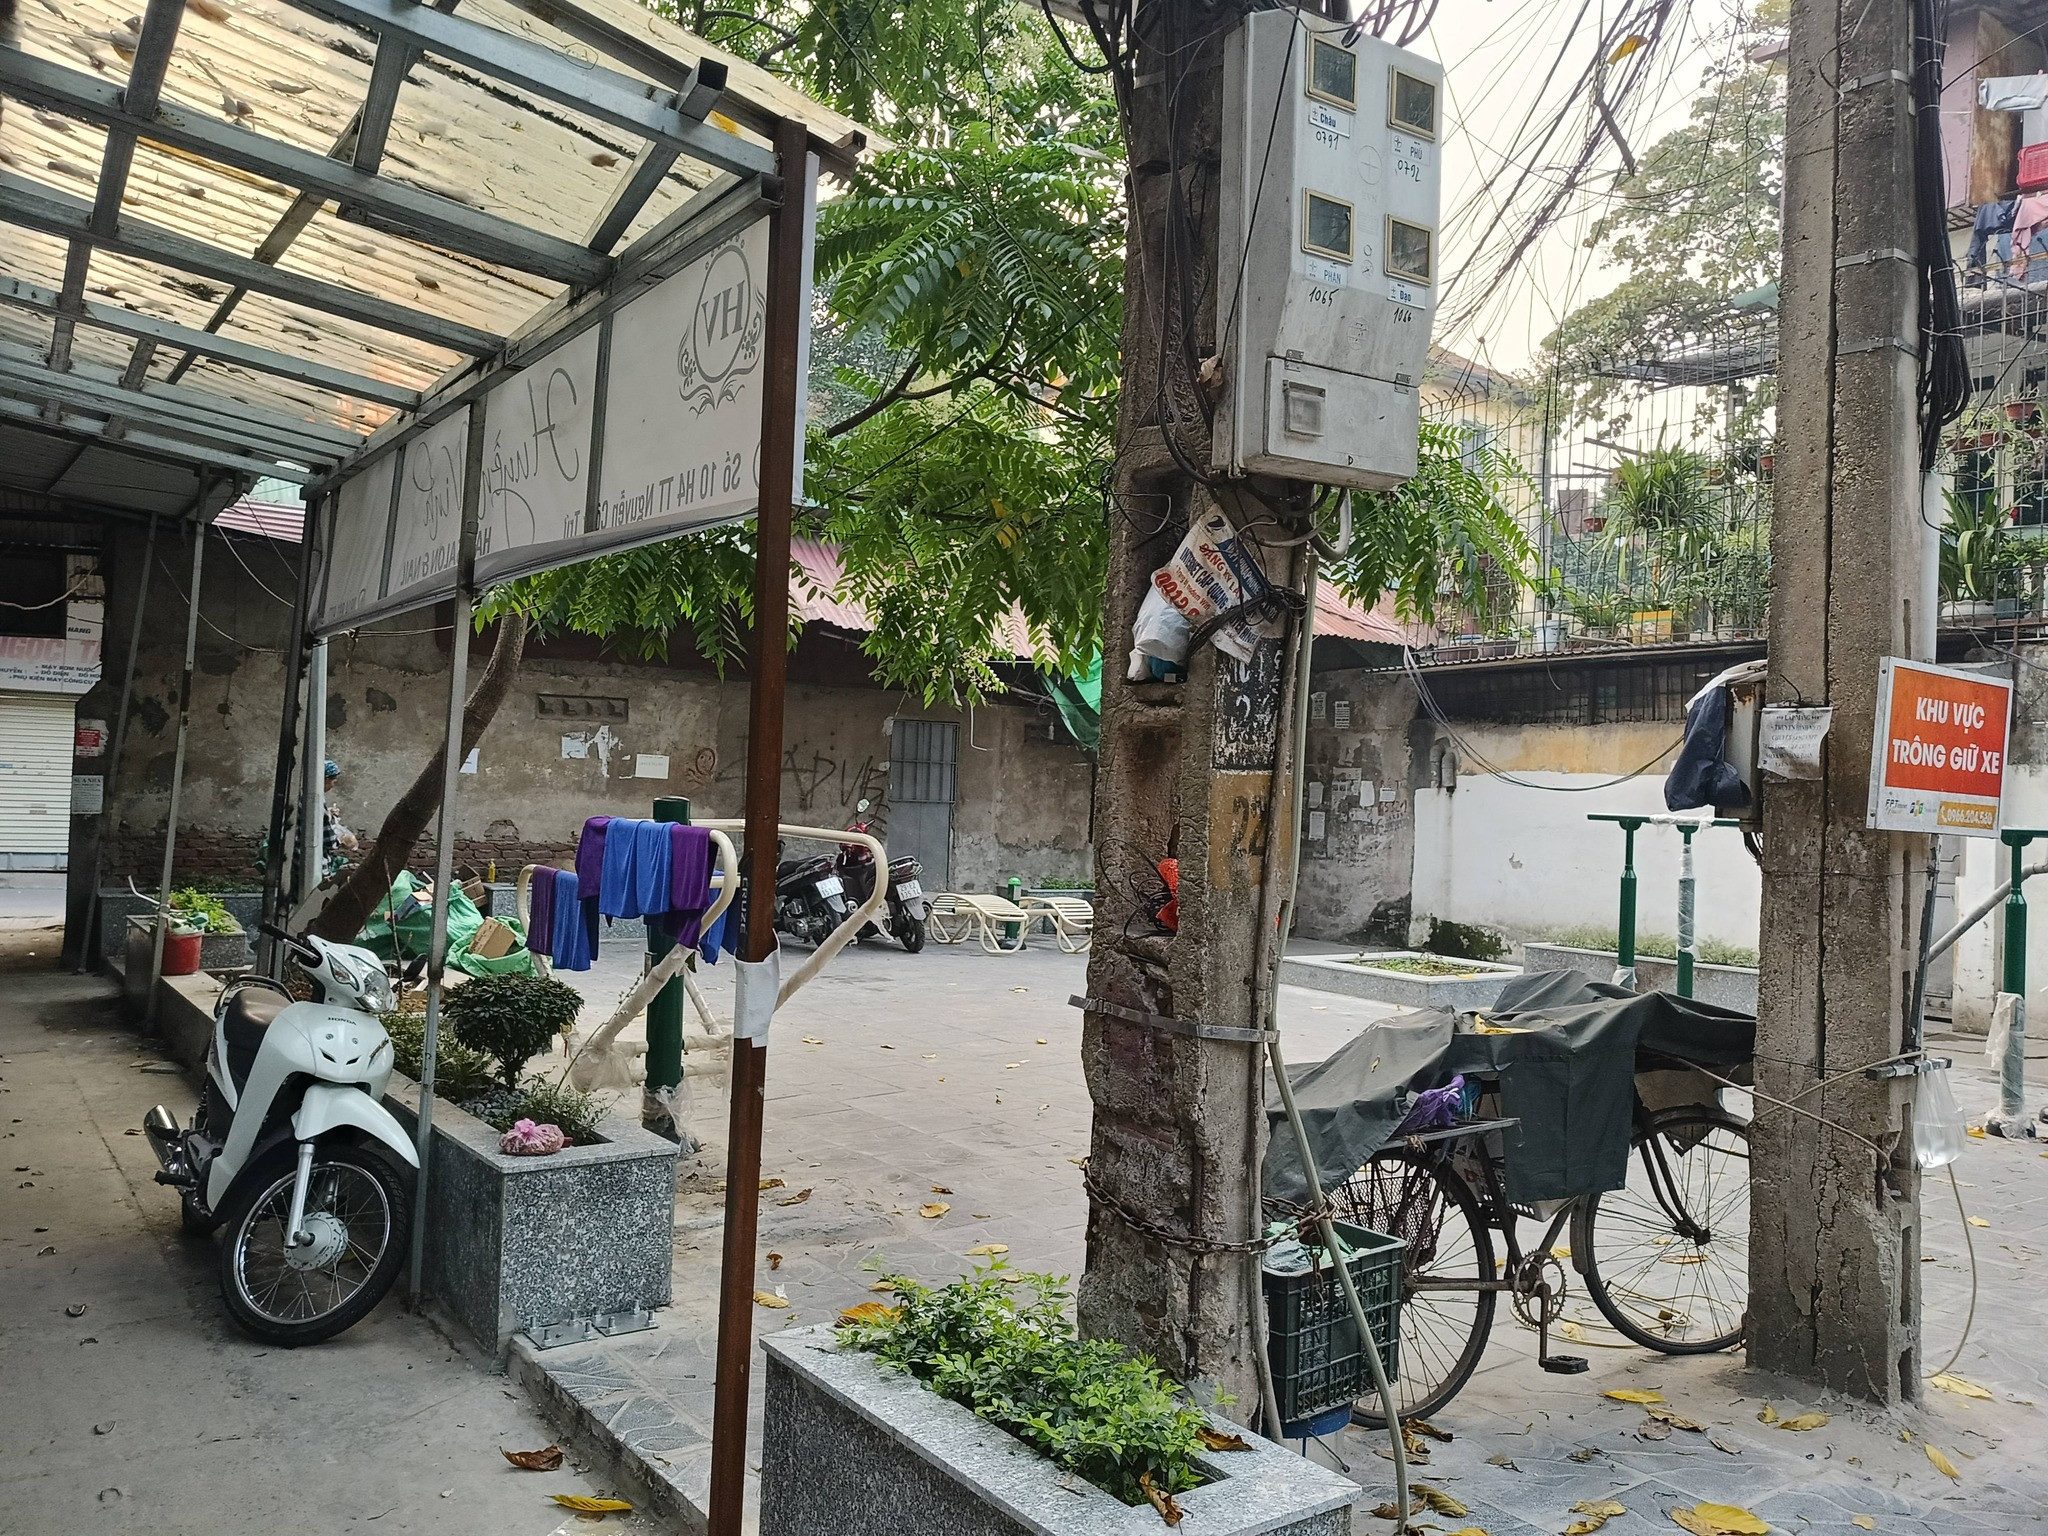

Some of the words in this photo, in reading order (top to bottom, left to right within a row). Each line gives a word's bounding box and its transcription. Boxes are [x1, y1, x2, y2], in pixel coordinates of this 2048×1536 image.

[1316, 131, 1339, 150] 0791
[1397, 160, 1421, 182] 0792
[1309, 287, 1339, 307] 1065
[1195, 571, 1215, 589] CÁP
[1915, 697, 1949, 725] KHU
[1952, 700, 1985, 734] VỰC
[1892, 735, 1946, 769] TRÔNG
[1949, 744, 1979, 773] GIỮ
[1980, 751, 2000, 775] XE
[327, 1017, 357, 1026] HONDA
